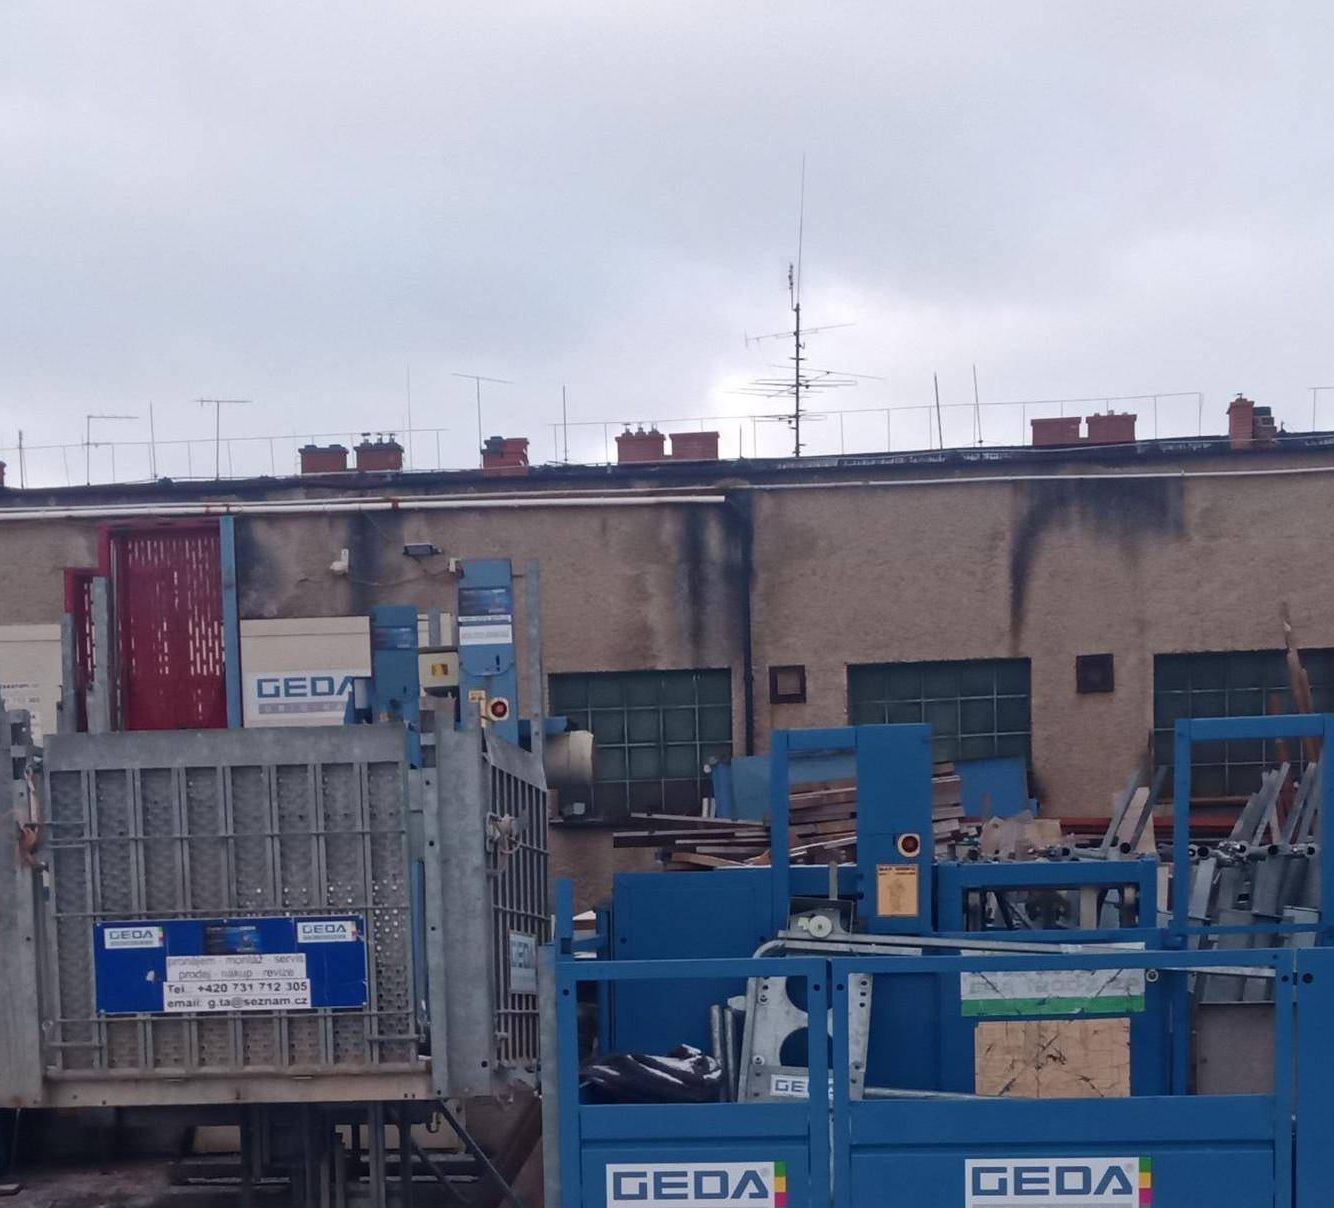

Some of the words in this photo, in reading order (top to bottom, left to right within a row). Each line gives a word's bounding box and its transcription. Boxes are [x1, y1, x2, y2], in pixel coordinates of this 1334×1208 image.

[109, 930, 153, 940] GEDA
[302, 924, 346, 934] GEDA
[197, 983, 227, 993] +420
[233, 983, 253, 992] 731
[259, 982, 280, 991] 712
[287, 981, 307, 991] 305
[613, 1170, 768, 1201] GEDA
[972, 1165, 1133, 1196] GEDA
